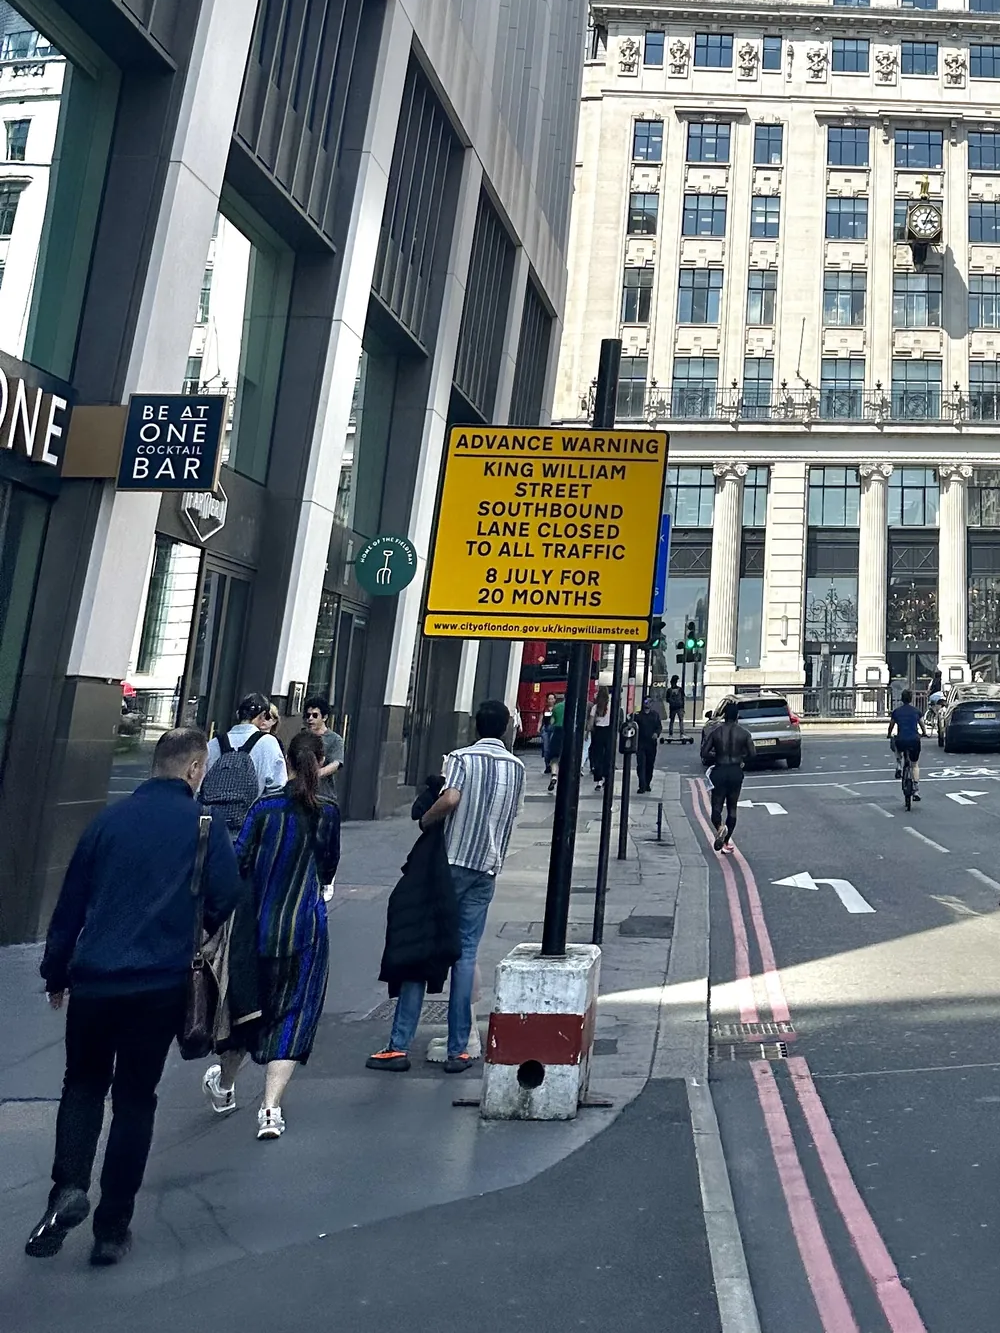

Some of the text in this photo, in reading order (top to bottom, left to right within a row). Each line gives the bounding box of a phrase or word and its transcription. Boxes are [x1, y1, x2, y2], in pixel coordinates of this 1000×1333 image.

[142, 405, 210, 421] BE AT
[139, 423, 207, 443] ONE
[136, 445, 203, 455] COCKTAIL
[455, 434, 660, 455] ADVANCE WARNING
[132, 457, 201, 480] BAR
[483, 461, 627, 481] KING WILLIAM
[514, 481, 593, 499] STREET
[477, 500, 624, 520] SOUTHBOUND
[476, 521, 621, 540] LANE CLOSED
[360, 545, 373, 563] HOME
[372, 539, 381, 547] OF
[465, 540, 627, 561] TO ALL TRAFFIC
[485, 567, 601, 587] 8 JULY FOR
[477, 588, 603, 608] 20 MONTHS
[433, 621, 640, 636] www.cityoflondon.gov.uk/kingwilliamstreet
